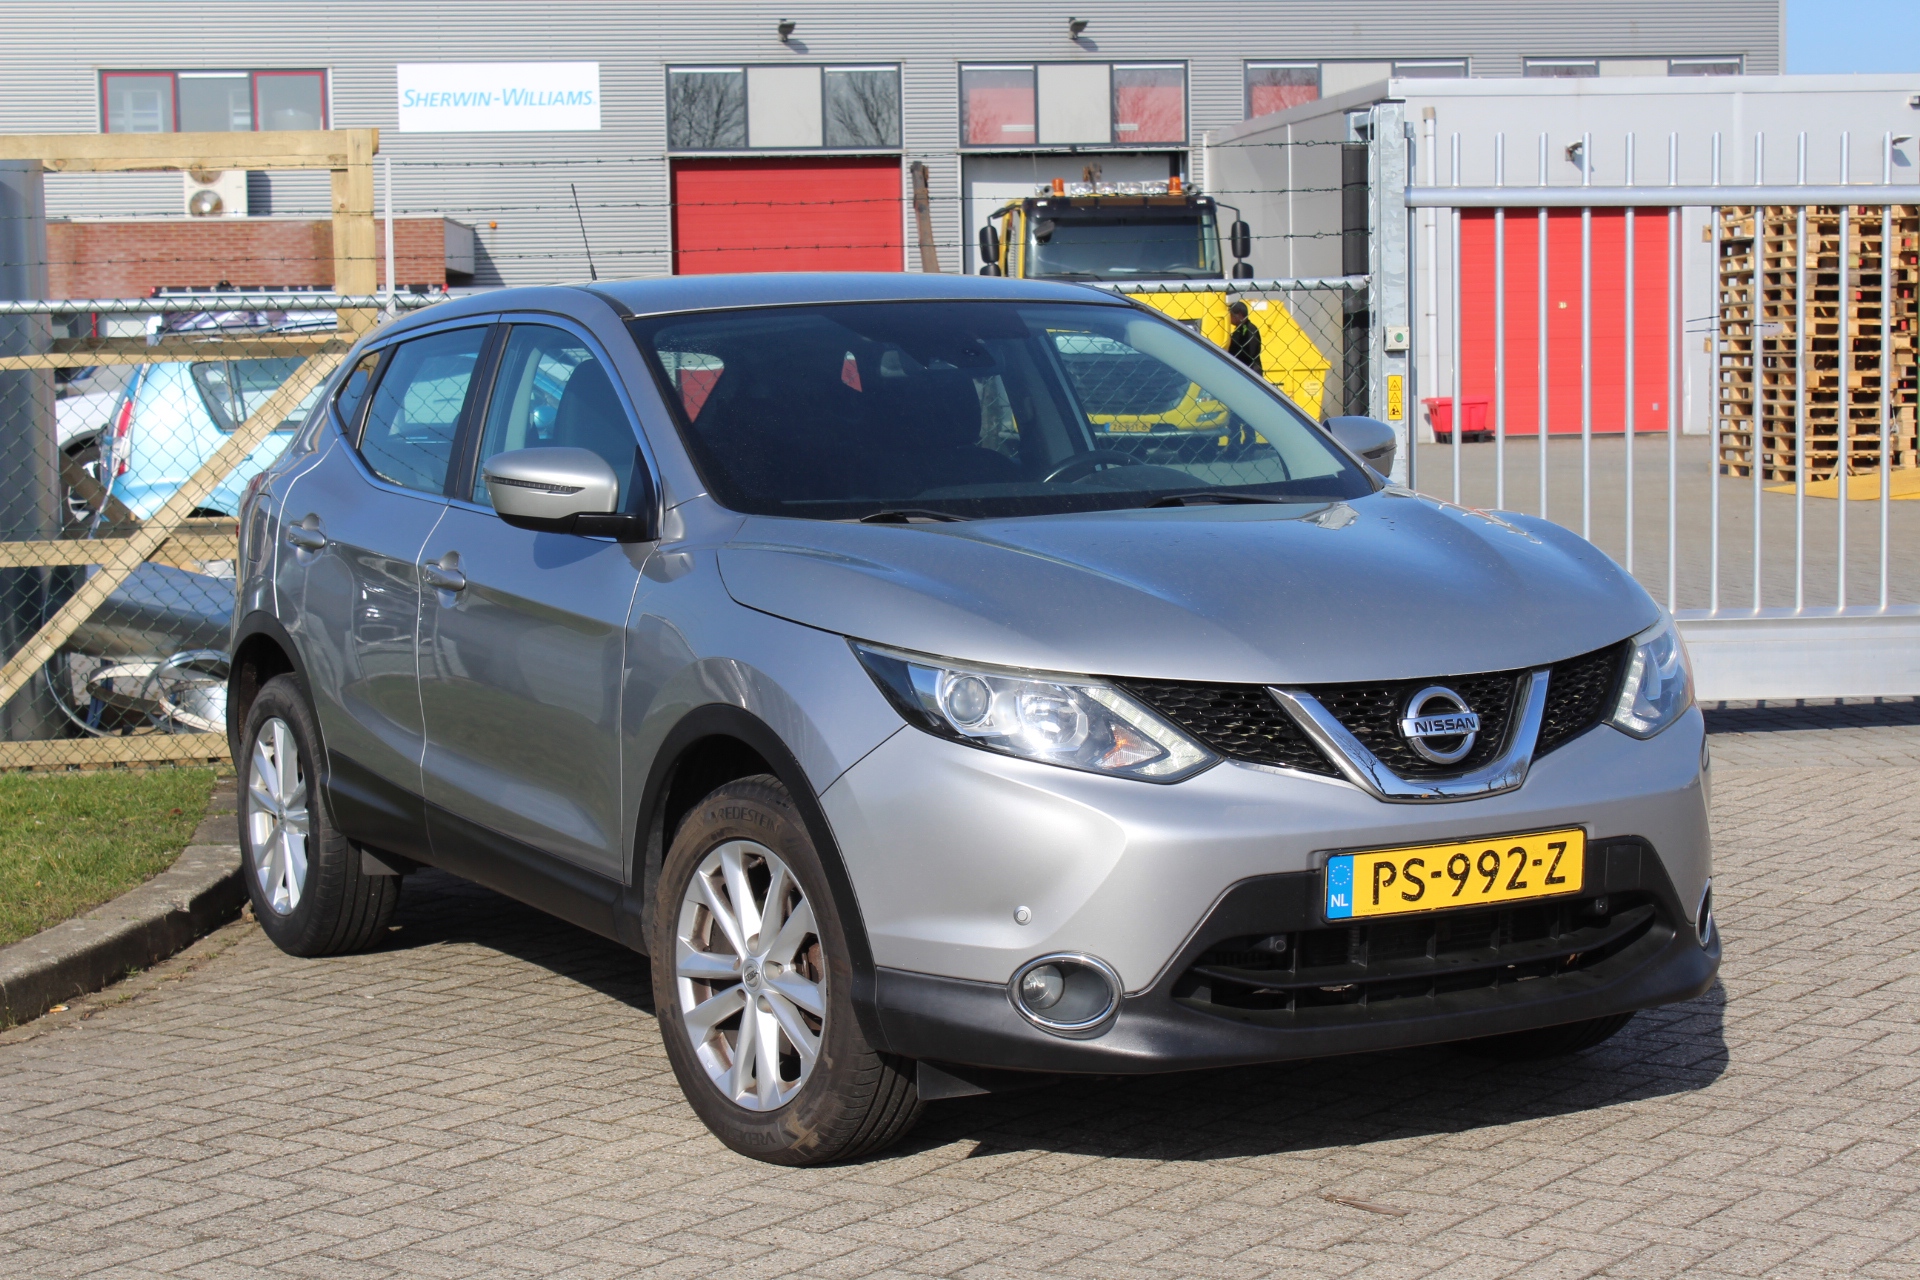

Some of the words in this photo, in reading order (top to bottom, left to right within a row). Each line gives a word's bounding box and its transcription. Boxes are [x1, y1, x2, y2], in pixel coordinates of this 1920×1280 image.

[402, 88, 594, 107] SHERWIN-WILLIAMS
[1414, 717, 1476, 733] NISSAN
[1372, 841, 1568, 905] PS-992-Z
[1331, 893, 1349, 908] NL
